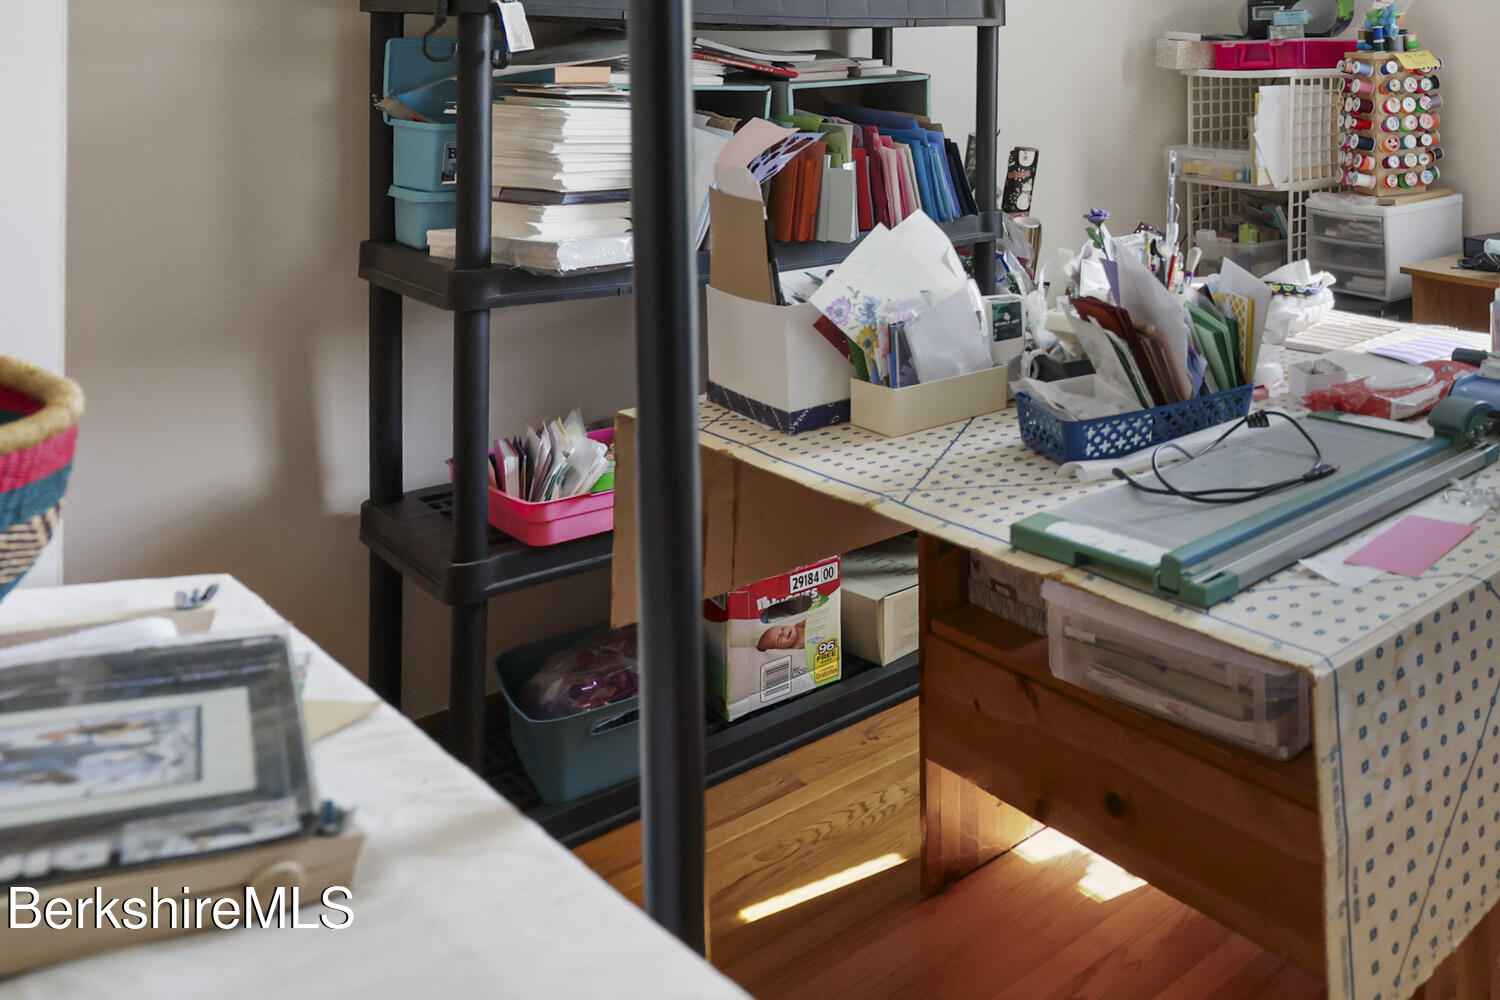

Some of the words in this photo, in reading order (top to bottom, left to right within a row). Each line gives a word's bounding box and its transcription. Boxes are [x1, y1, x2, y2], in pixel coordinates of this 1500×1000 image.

[792, 572, 819, 590] 29184
[823, 566, 834, 579] 00
[819, 640, 835, 654] 96
[816, 650, 837, 662] FREE
